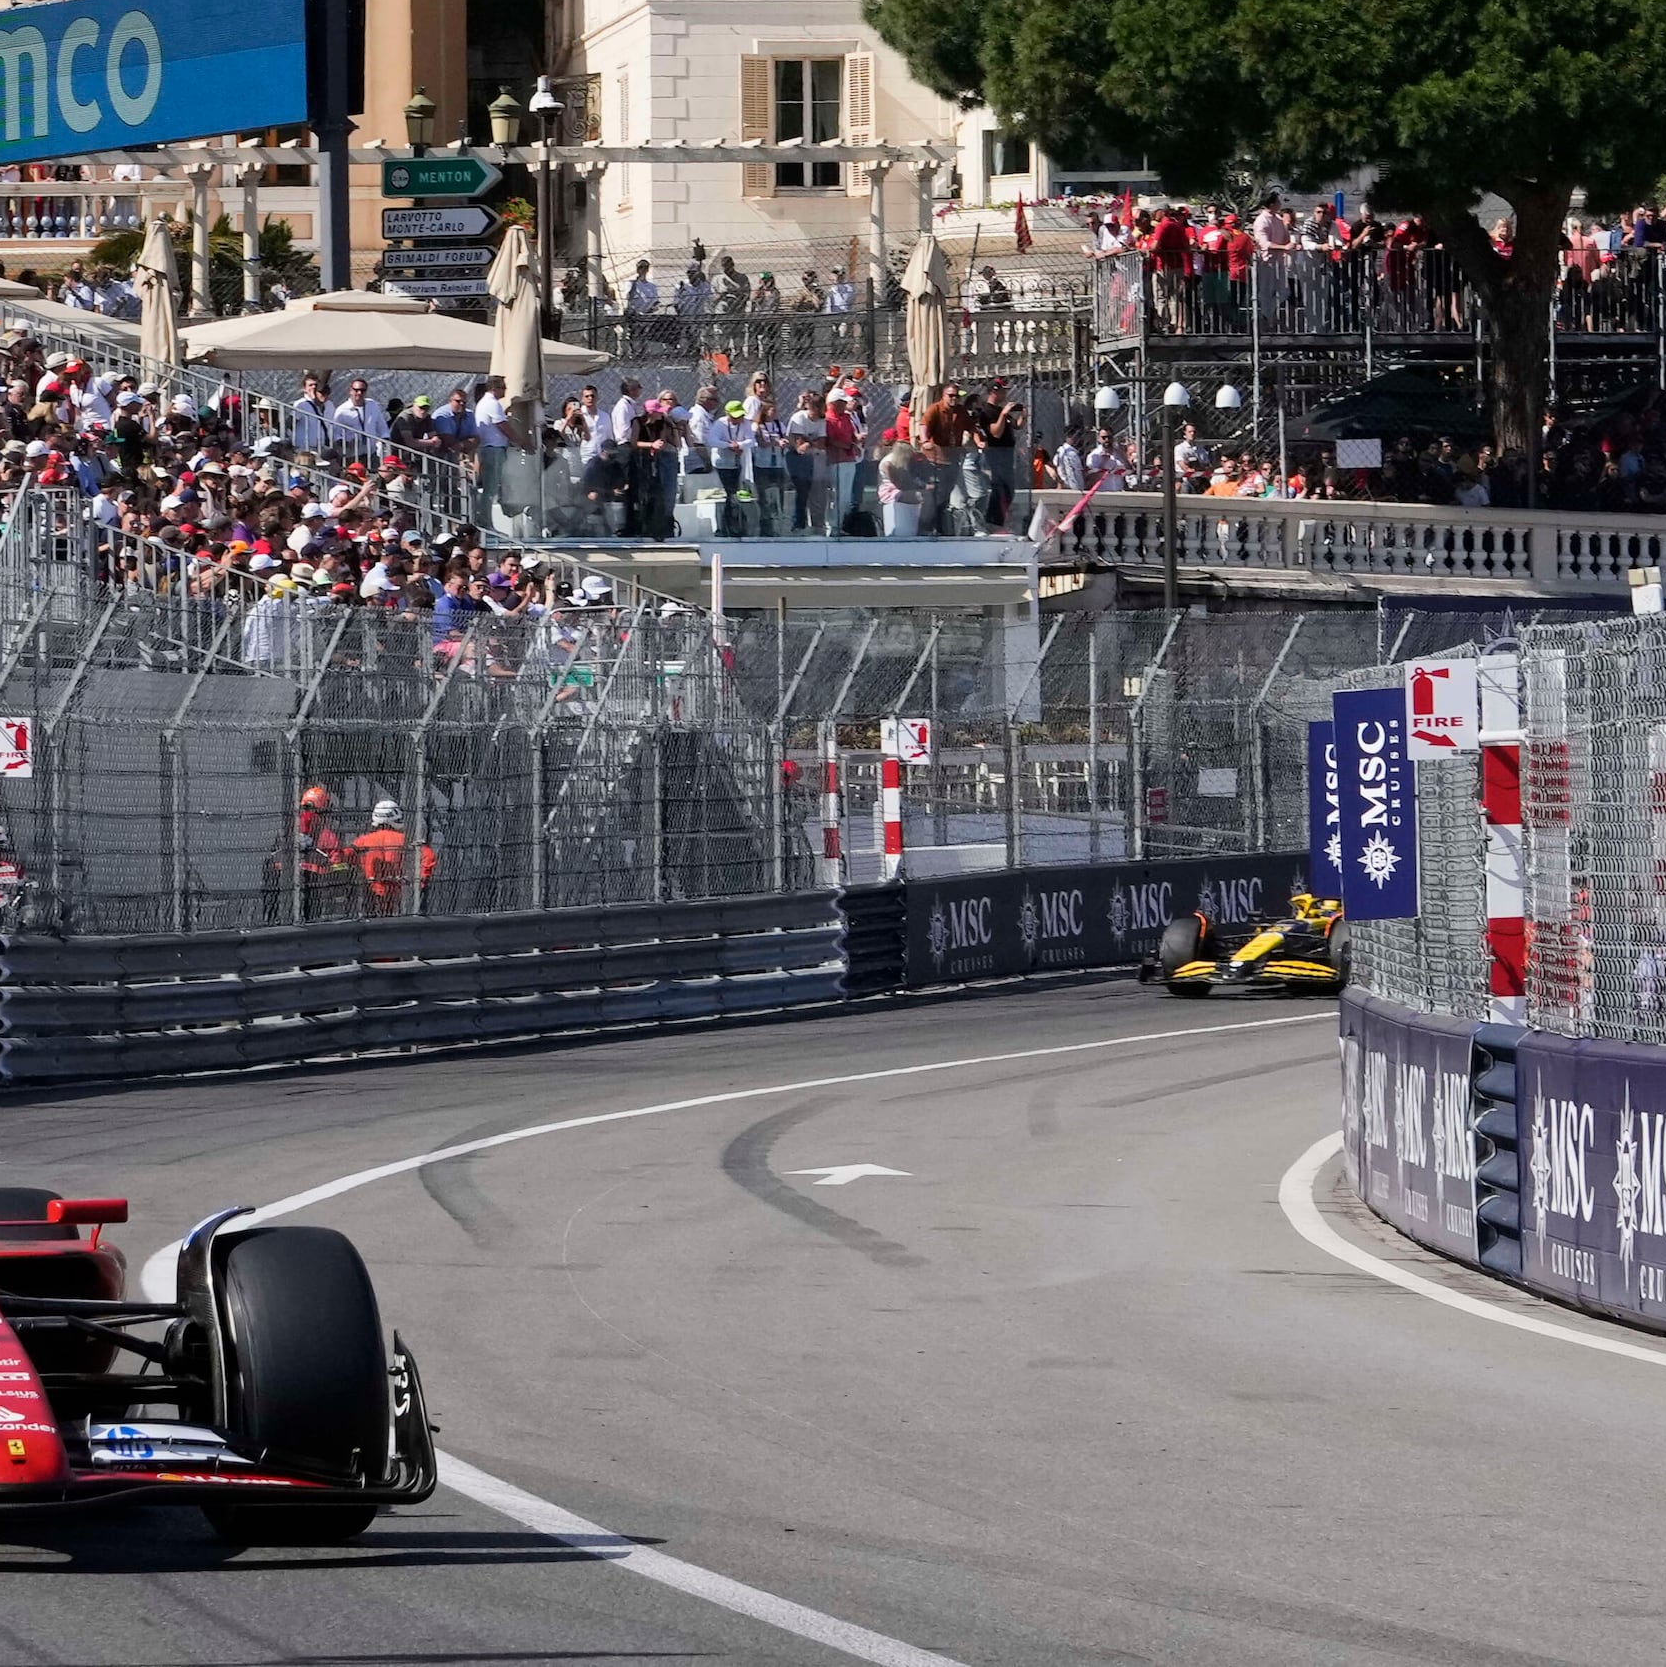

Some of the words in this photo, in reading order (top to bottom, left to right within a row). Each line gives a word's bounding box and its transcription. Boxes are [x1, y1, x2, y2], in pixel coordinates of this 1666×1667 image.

[418, 171, 472, 183] MENTON
[387, 213, 442, 223] LARVOTTO
[387, 223, 465, 233] MONTE-CARLO
[387, 253, 439, 264] GRIMALDI
[445, 252, 483, 262] FORUM
[440, 284, 472, 292] Rainier
[1414, 717, 1464, 728] FIRE
[1358, 721, 1388, 828] MSC
[1389, 720, 1402, 826] CRUISES
[950, 897, 993, 950] MSC
[1040, 889, 1083, 942] MSC
[1130, 882, 1173, 930] MSC
[1219, 877, 1264, 924] MSC
[1371, 1051, 1389, 1150] MSC
[1403, 1063, 1427, 1168] MSC
[1444, 1072, 1470, 1181] MSC
[1550, 1098, 1595, 1222] MSC
[1551, 1243, 1595, 1286] CRUISES
[107, 1426, 154, 1457] hp
